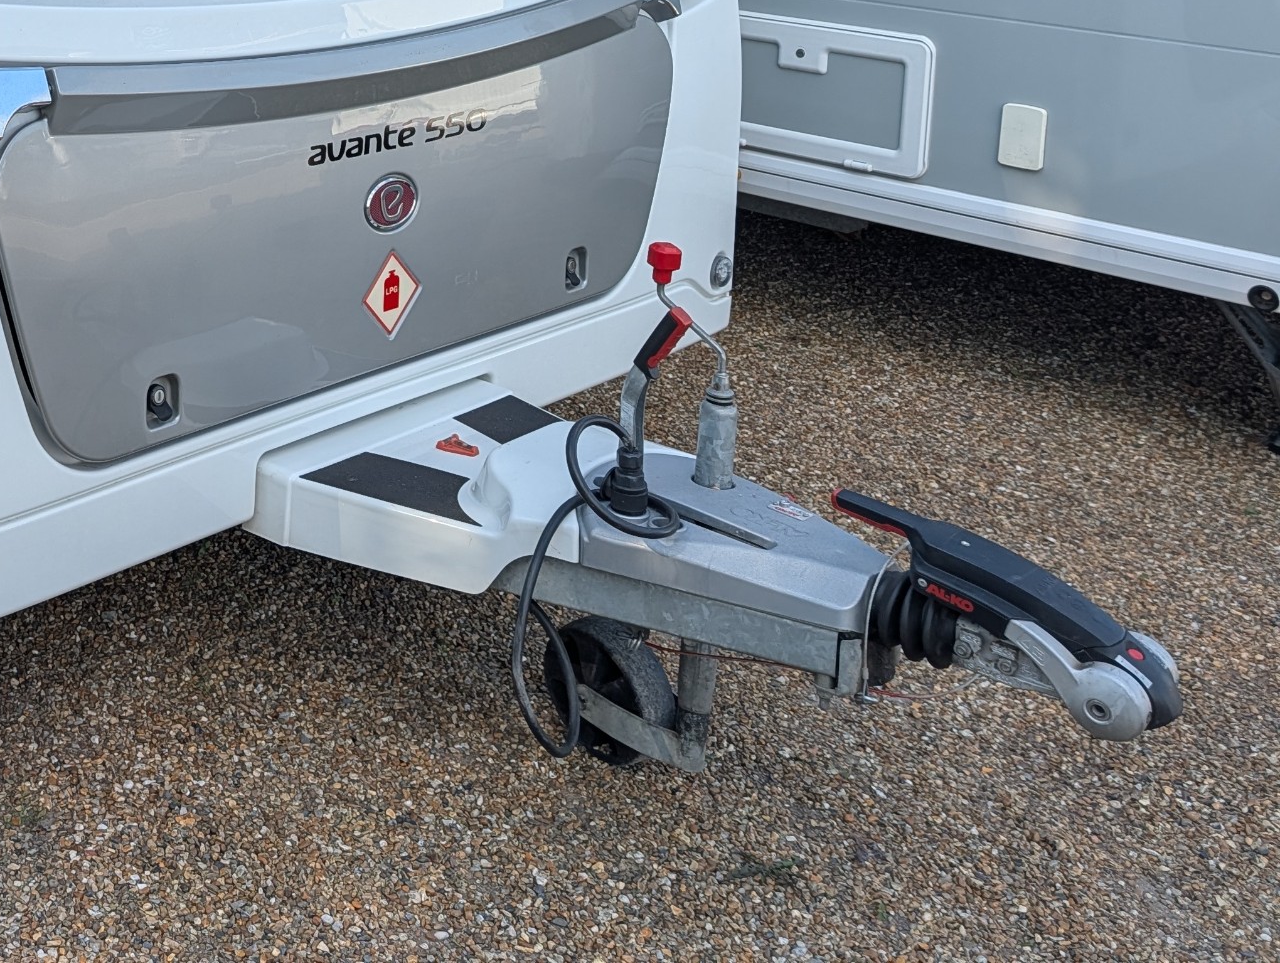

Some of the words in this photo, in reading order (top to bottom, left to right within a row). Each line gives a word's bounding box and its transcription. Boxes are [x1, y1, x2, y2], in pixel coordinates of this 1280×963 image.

[307, 120, 417, 167] avanté
[424, 108, 488, 143] 550
[385, 285, 399, 296] LPG
[925, 583, 975, 613] AL-KO
